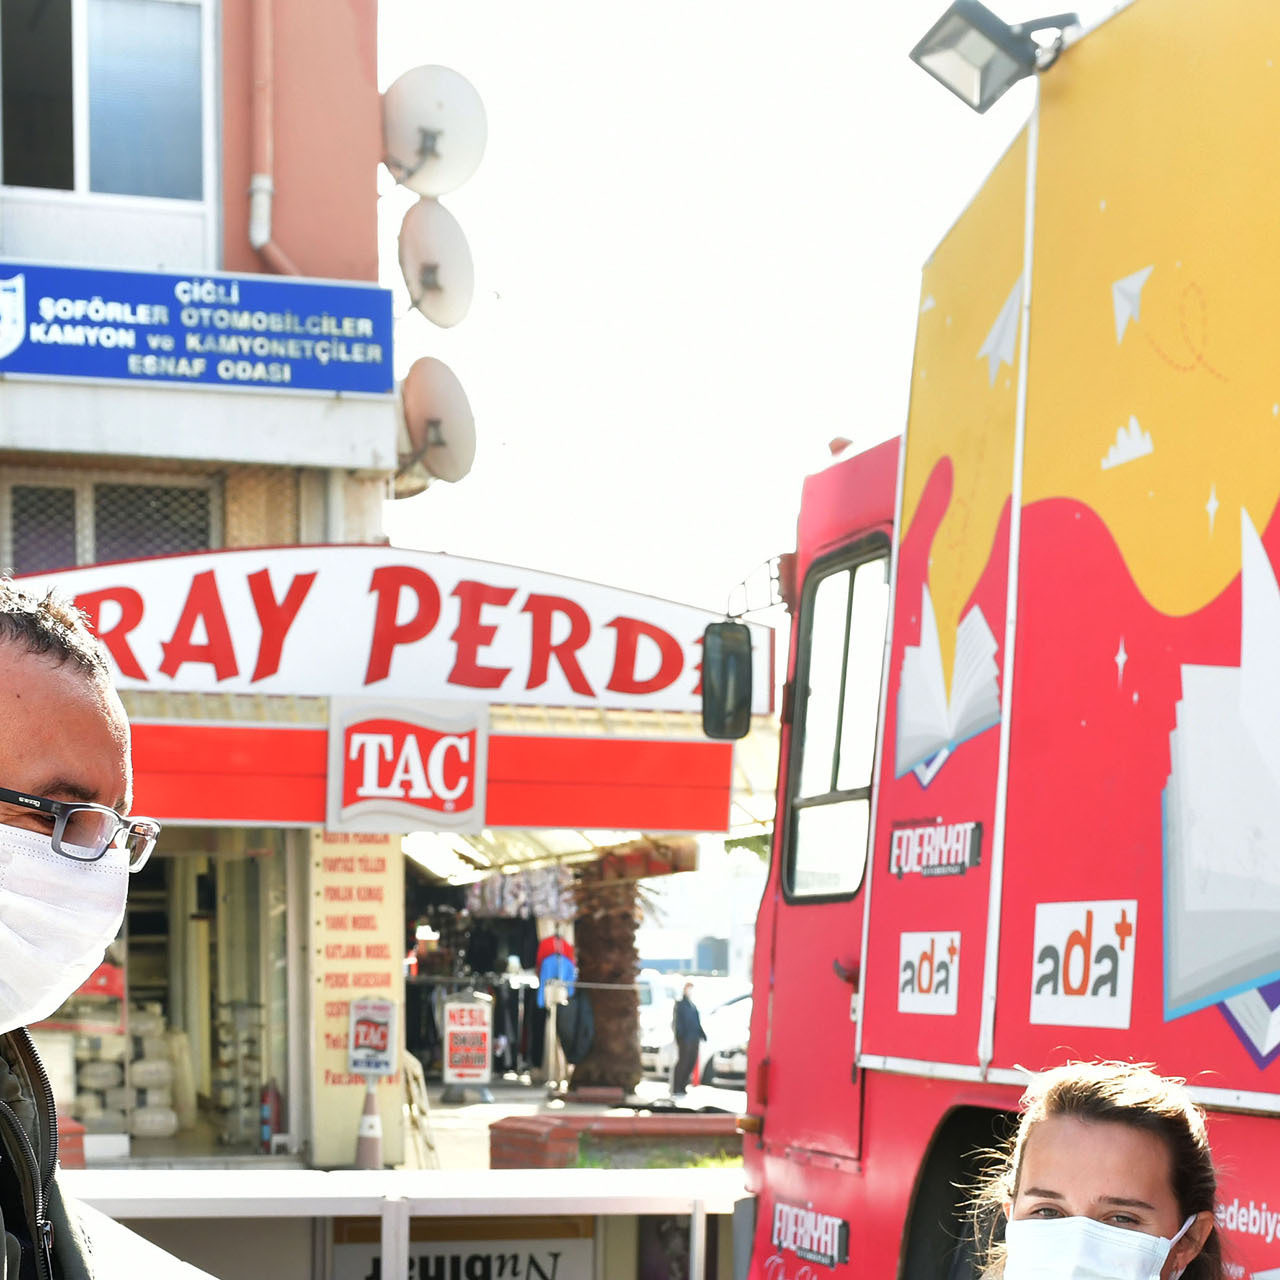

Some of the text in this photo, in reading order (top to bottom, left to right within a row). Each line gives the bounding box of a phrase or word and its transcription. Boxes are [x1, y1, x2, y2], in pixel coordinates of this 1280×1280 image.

[174, 279, 240, 305] ÇİĞLİ
[39, 296, 169, 325] ŞOFÖRLER
[30, 323, 135, 349] KAMYON
[185, 334, 382, 364] KAMYONETÇİLER
[128, 354, 291, 383] ESNAF ODASI
[73, 565, 705, 698] RAY PERD
